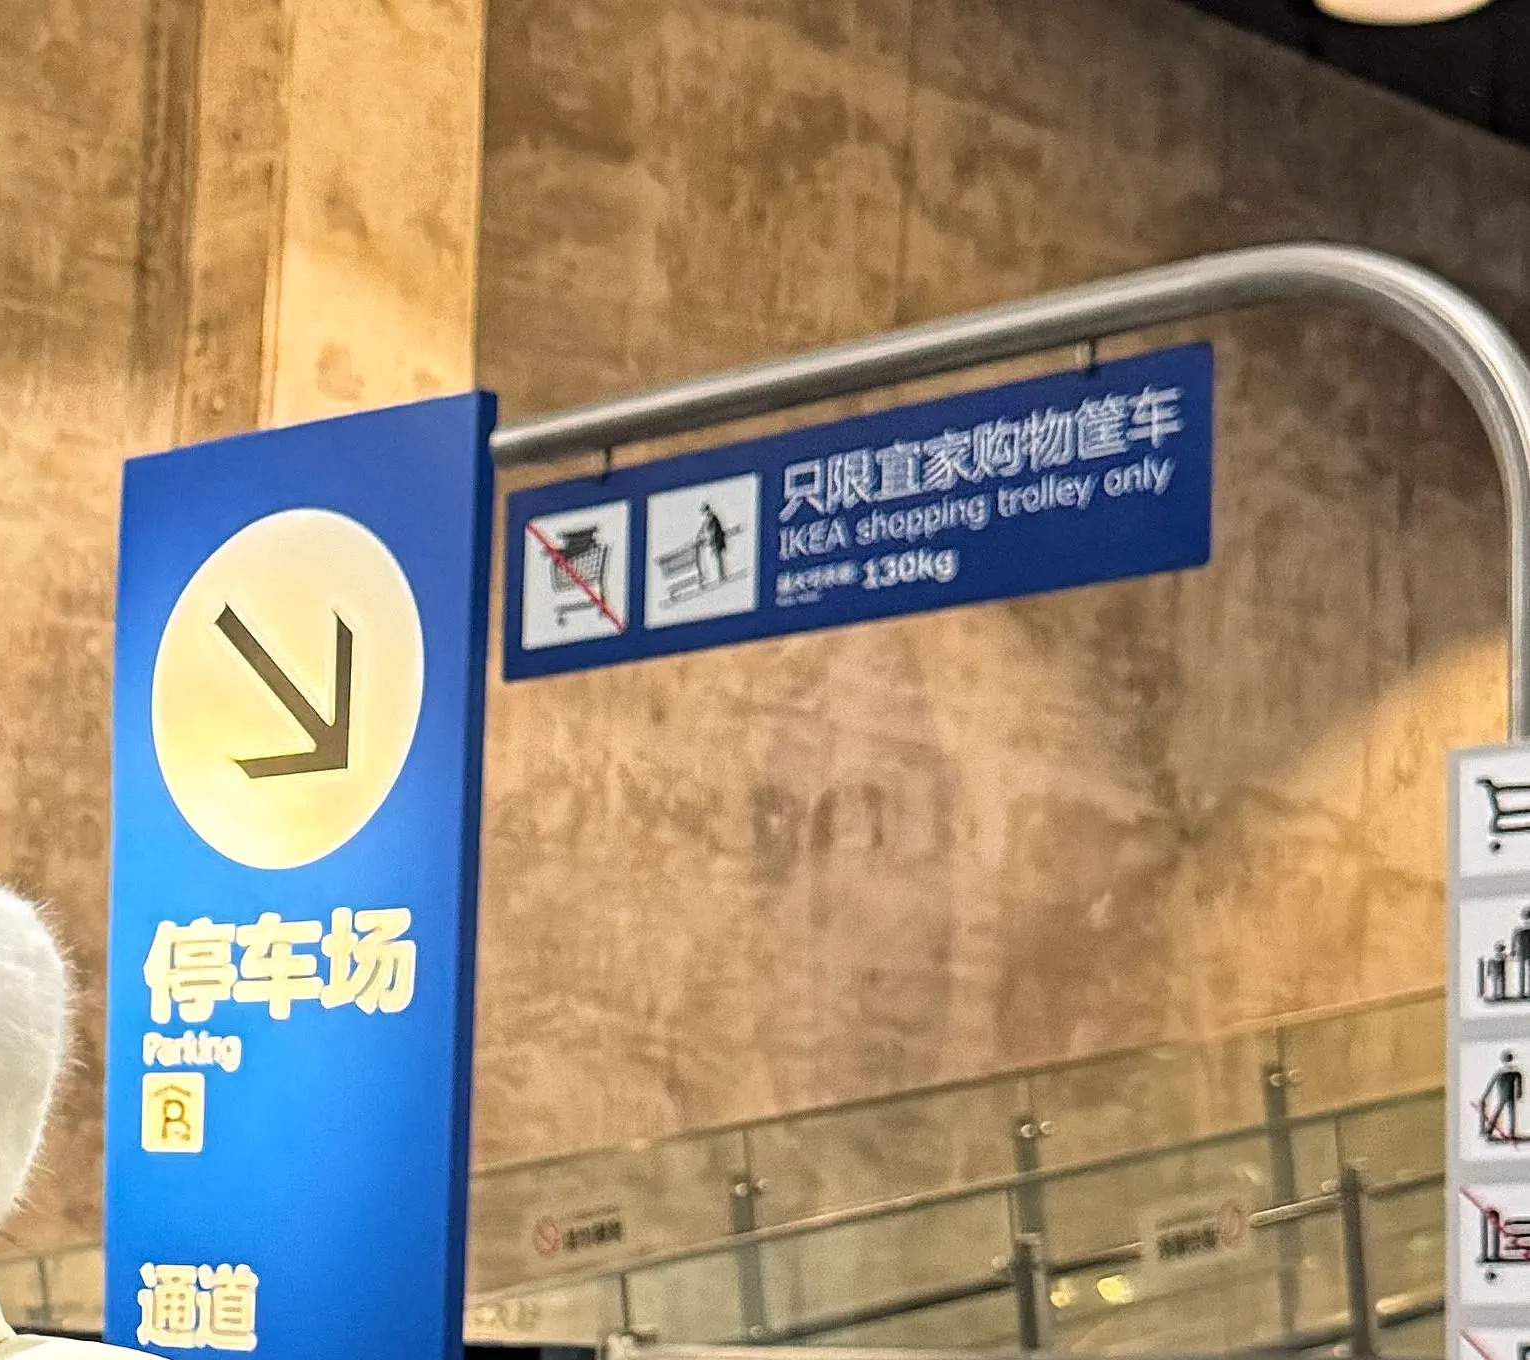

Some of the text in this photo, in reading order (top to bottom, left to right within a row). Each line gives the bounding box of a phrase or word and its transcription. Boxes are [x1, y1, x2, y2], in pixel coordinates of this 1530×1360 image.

[779, 454, 1177, 561] IKEA shopping trolley only
[143, 907, 417, 1024] 停车场
[142, 1030, 243, 1073] Parking
[137, 1263, 260, 1351] 通道
